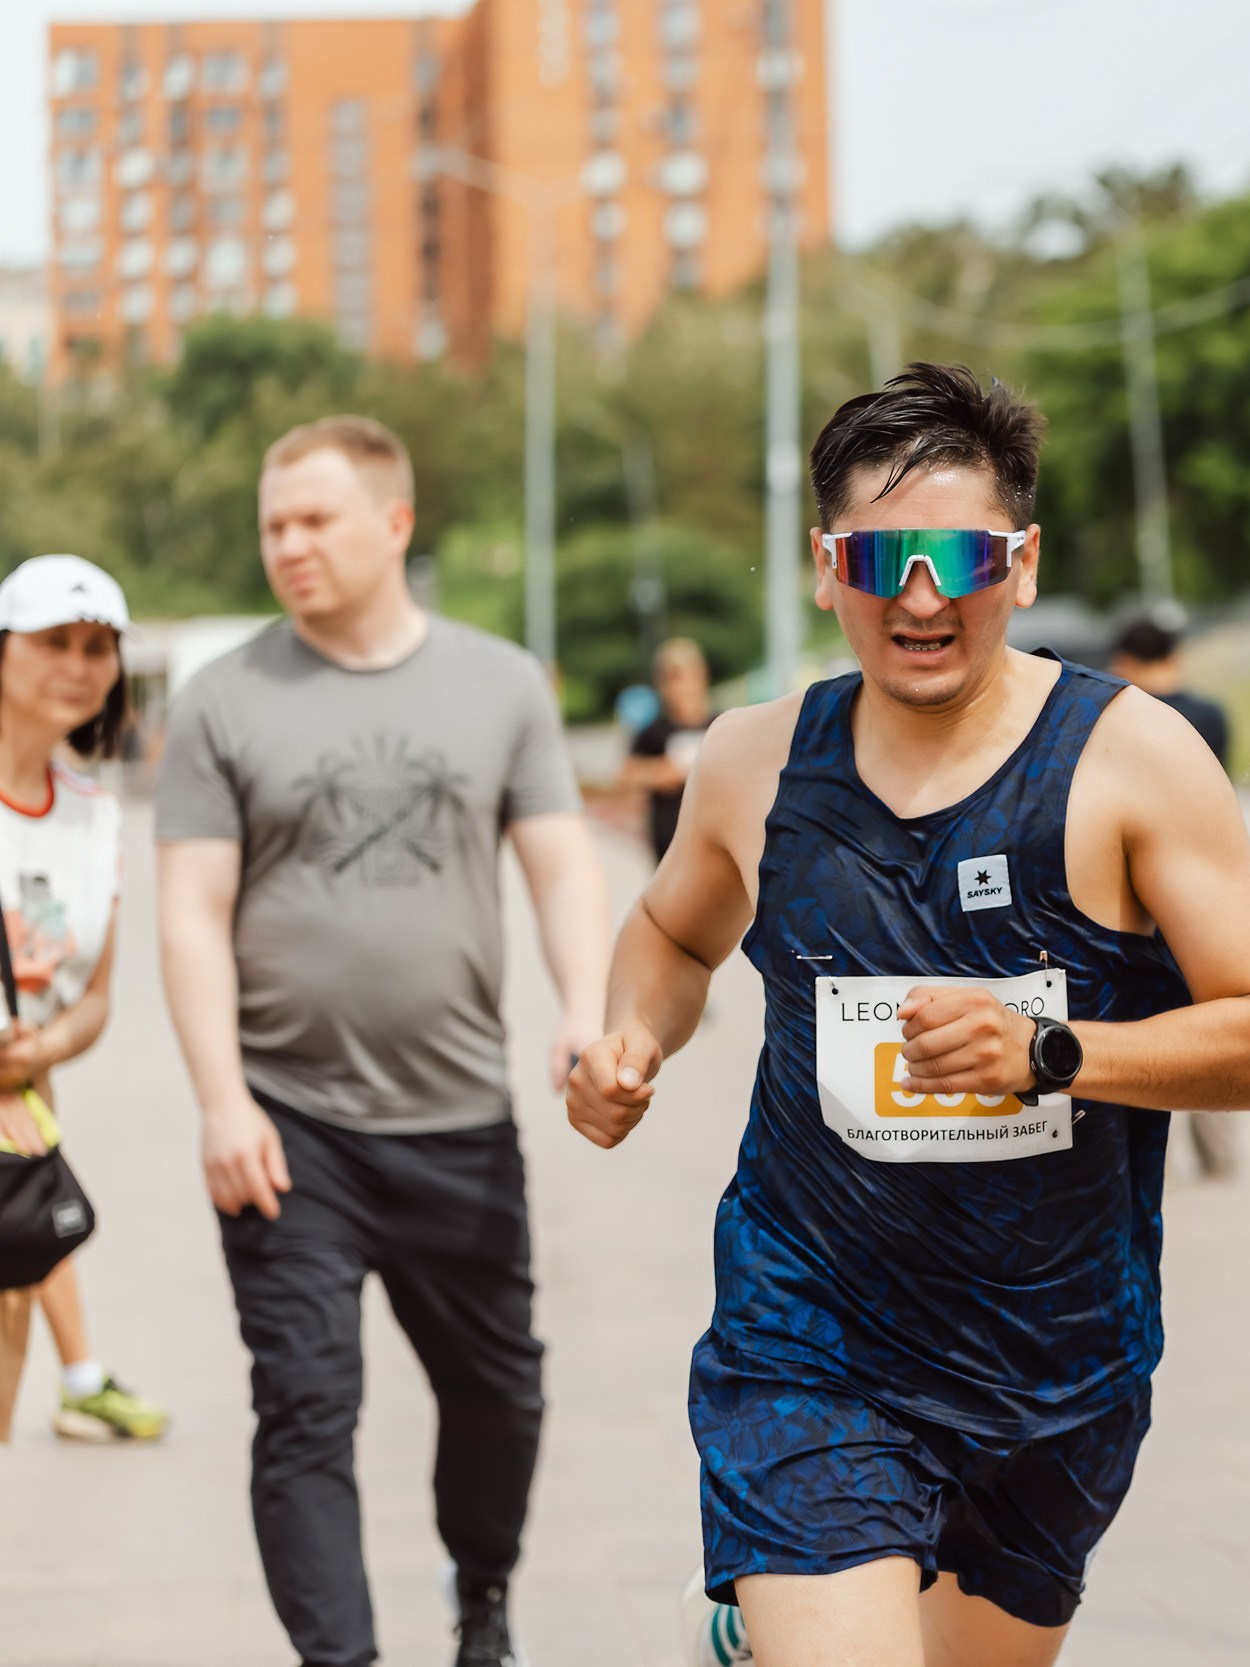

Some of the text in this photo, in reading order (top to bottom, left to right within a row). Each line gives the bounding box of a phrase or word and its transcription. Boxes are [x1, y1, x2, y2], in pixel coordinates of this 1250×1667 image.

[967, 886, 1003, 899] SAYSKY
[847, 1120, 1048, 1142] БЛАГОТВОРИТЕЛЬНЫЙ ЗАБЕГ
